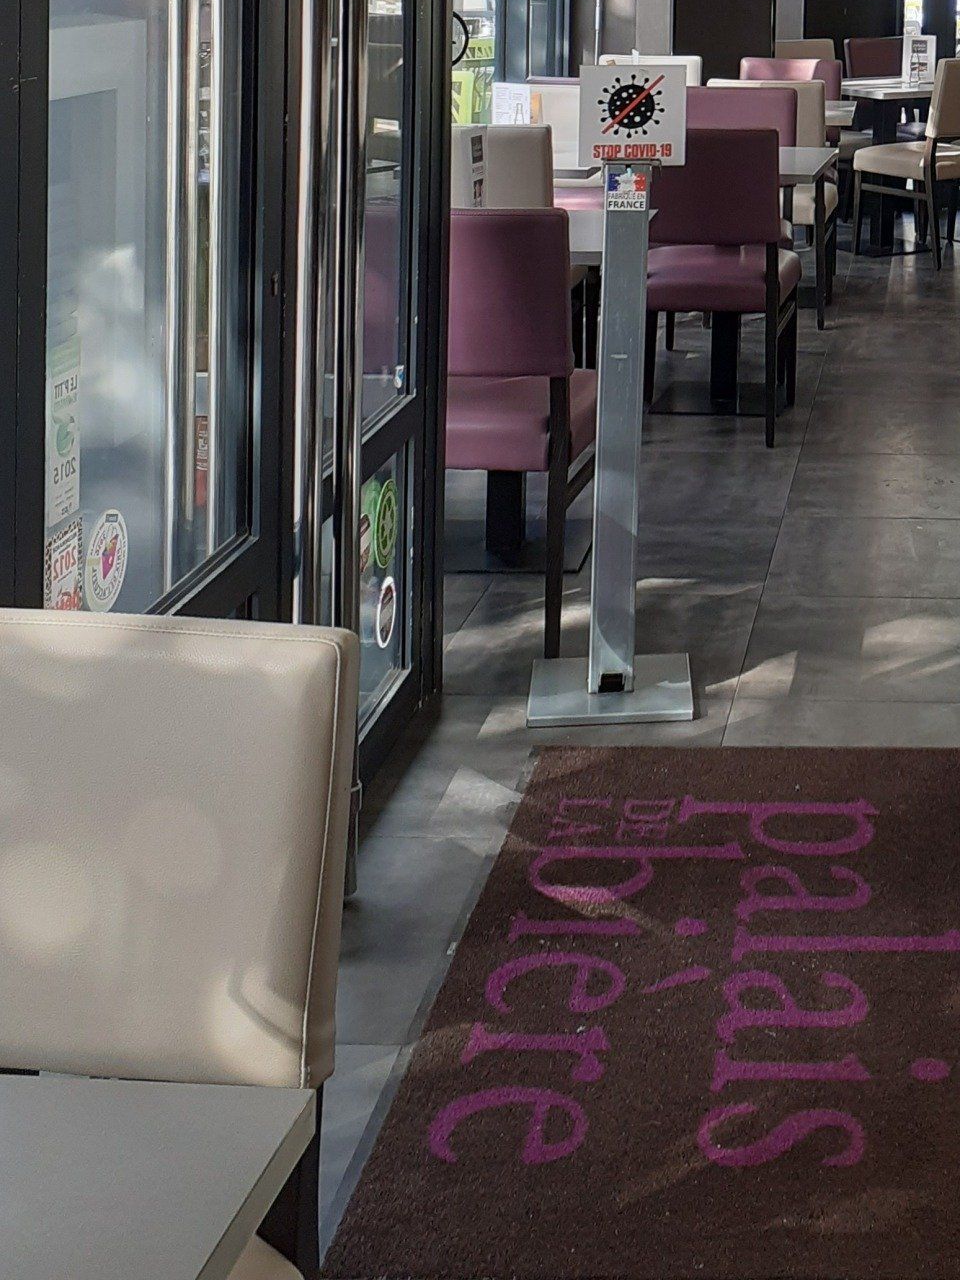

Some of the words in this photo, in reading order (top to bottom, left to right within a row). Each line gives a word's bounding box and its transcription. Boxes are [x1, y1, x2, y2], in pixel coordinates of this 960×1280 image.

[593, 144, 621, 159] STOP
[624, 143, 672, 158] COVID-19
[608, 201, 645, 209] FRANCE
[637, 192, 645, 200] EN
[547, 798, 613, 841] LA
[615, 799, 677, 841] DE
[427, 843, 745, 1166] bière
